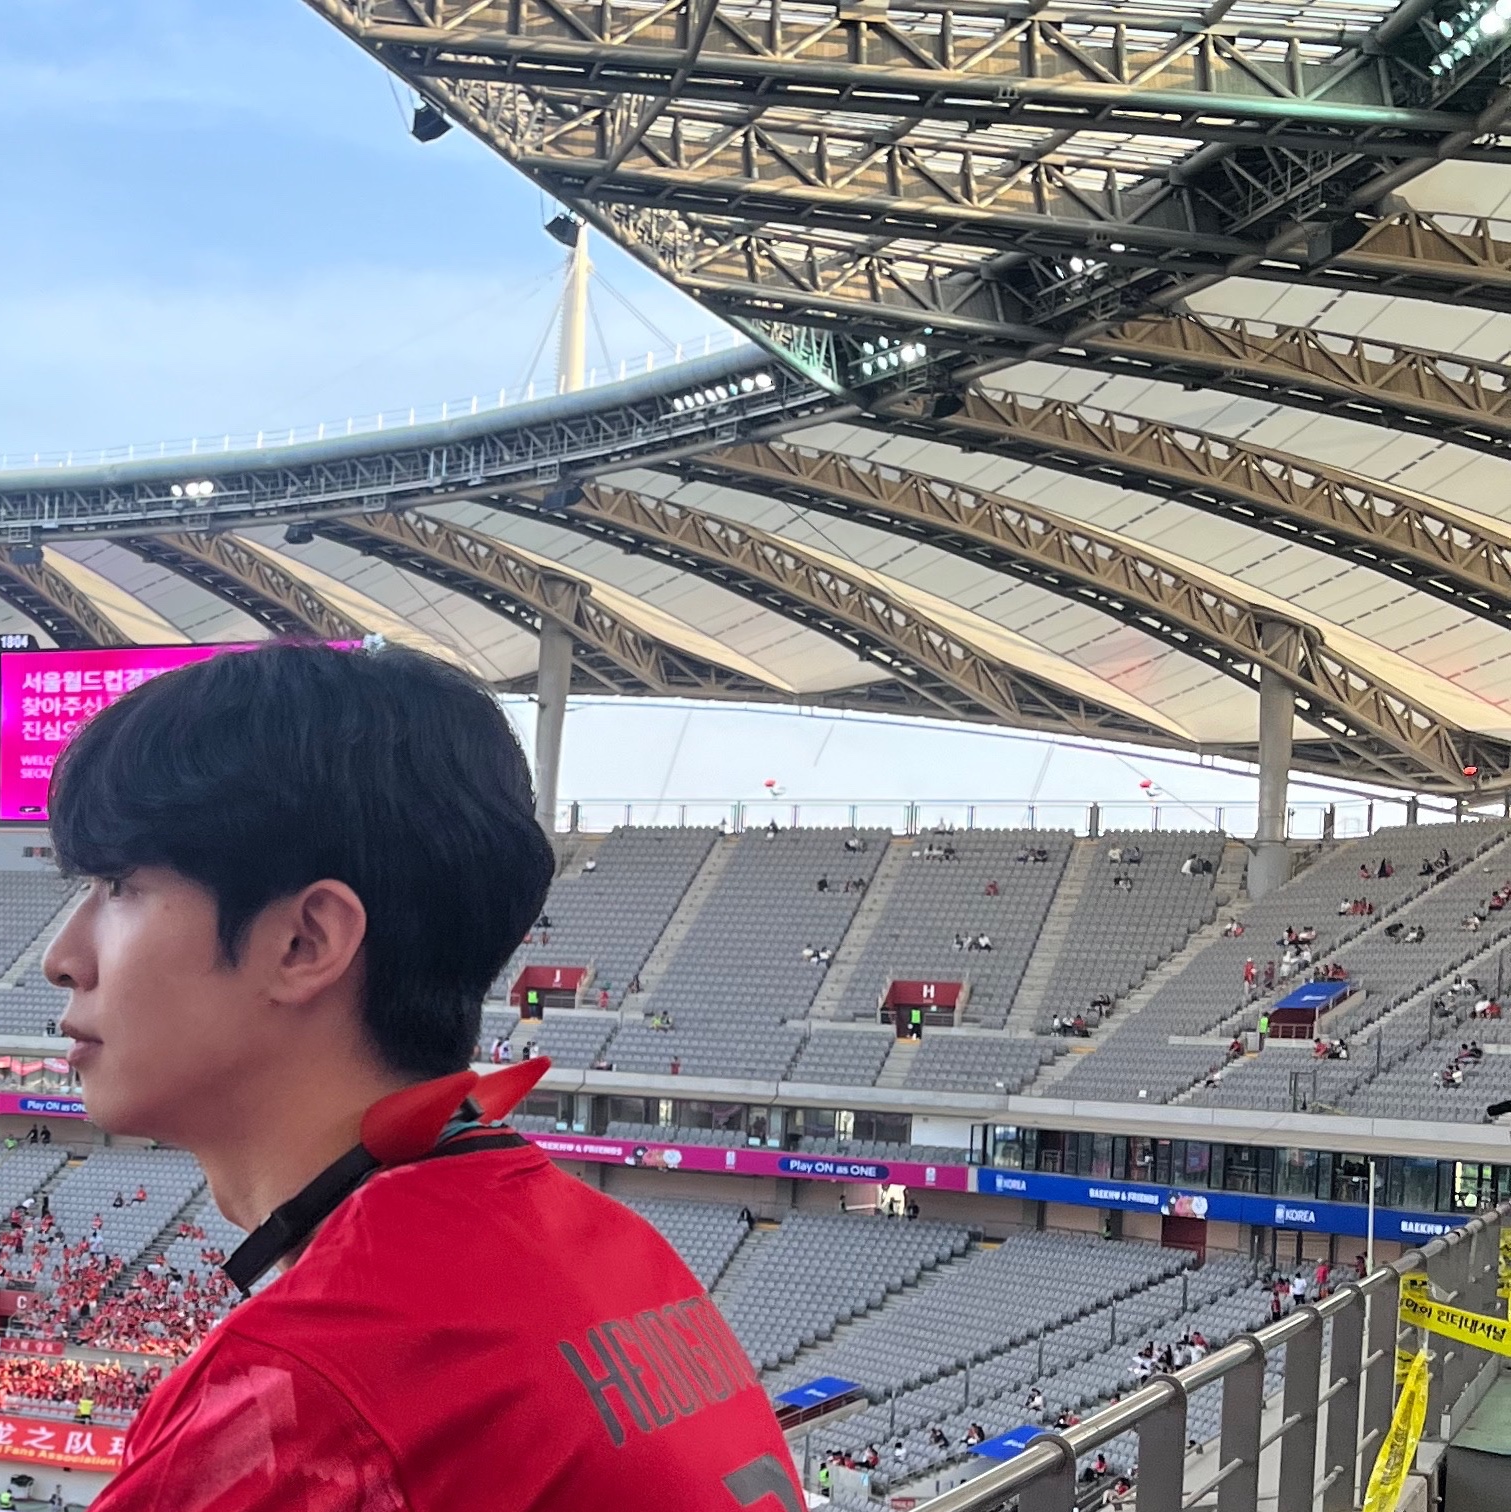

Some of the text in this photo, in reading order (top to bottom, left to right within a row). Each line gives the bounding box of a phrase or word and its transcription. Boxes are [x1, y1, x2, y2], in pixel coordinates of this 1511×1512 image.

[27, 1099, 45, 1112] Play
[45, 1101, 59, 1111] ON
[70, 1101, 87, 1112] ON
[789, 1159, 812, 1175] Play
[814, 1162, 834, 1173] ON
[850, 1165, 877, 1177] ONE
[1285, 1209, 1316, 1223] KOREA
[16, 1295, 28, 1310] C
[1437, 1309, 1507, 1343] 인터내셔널
[3, 1444, 36, 1457] Fans
[37, 1448, 116, 1466] Association
